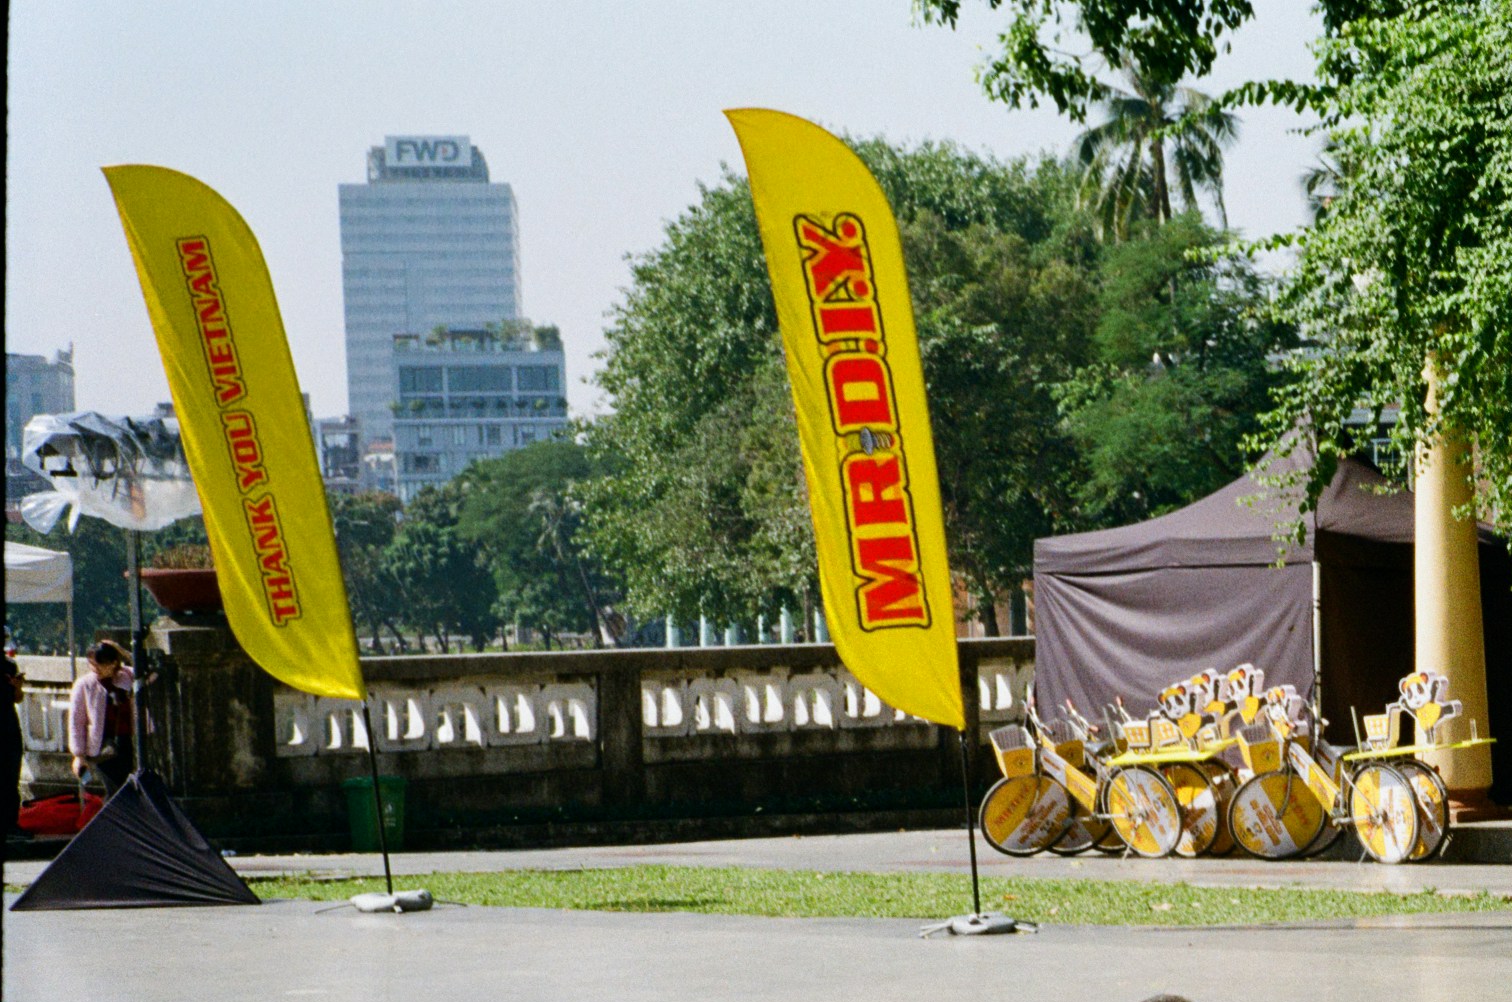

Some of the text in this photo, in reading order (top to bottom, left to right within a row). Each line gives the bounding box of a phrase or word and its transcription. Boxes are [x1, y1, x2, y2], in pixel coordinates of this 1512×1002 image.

[396, 140, 460, 162] FWD
[180, 239, 298, 624] THANK YOU VIETNAM
